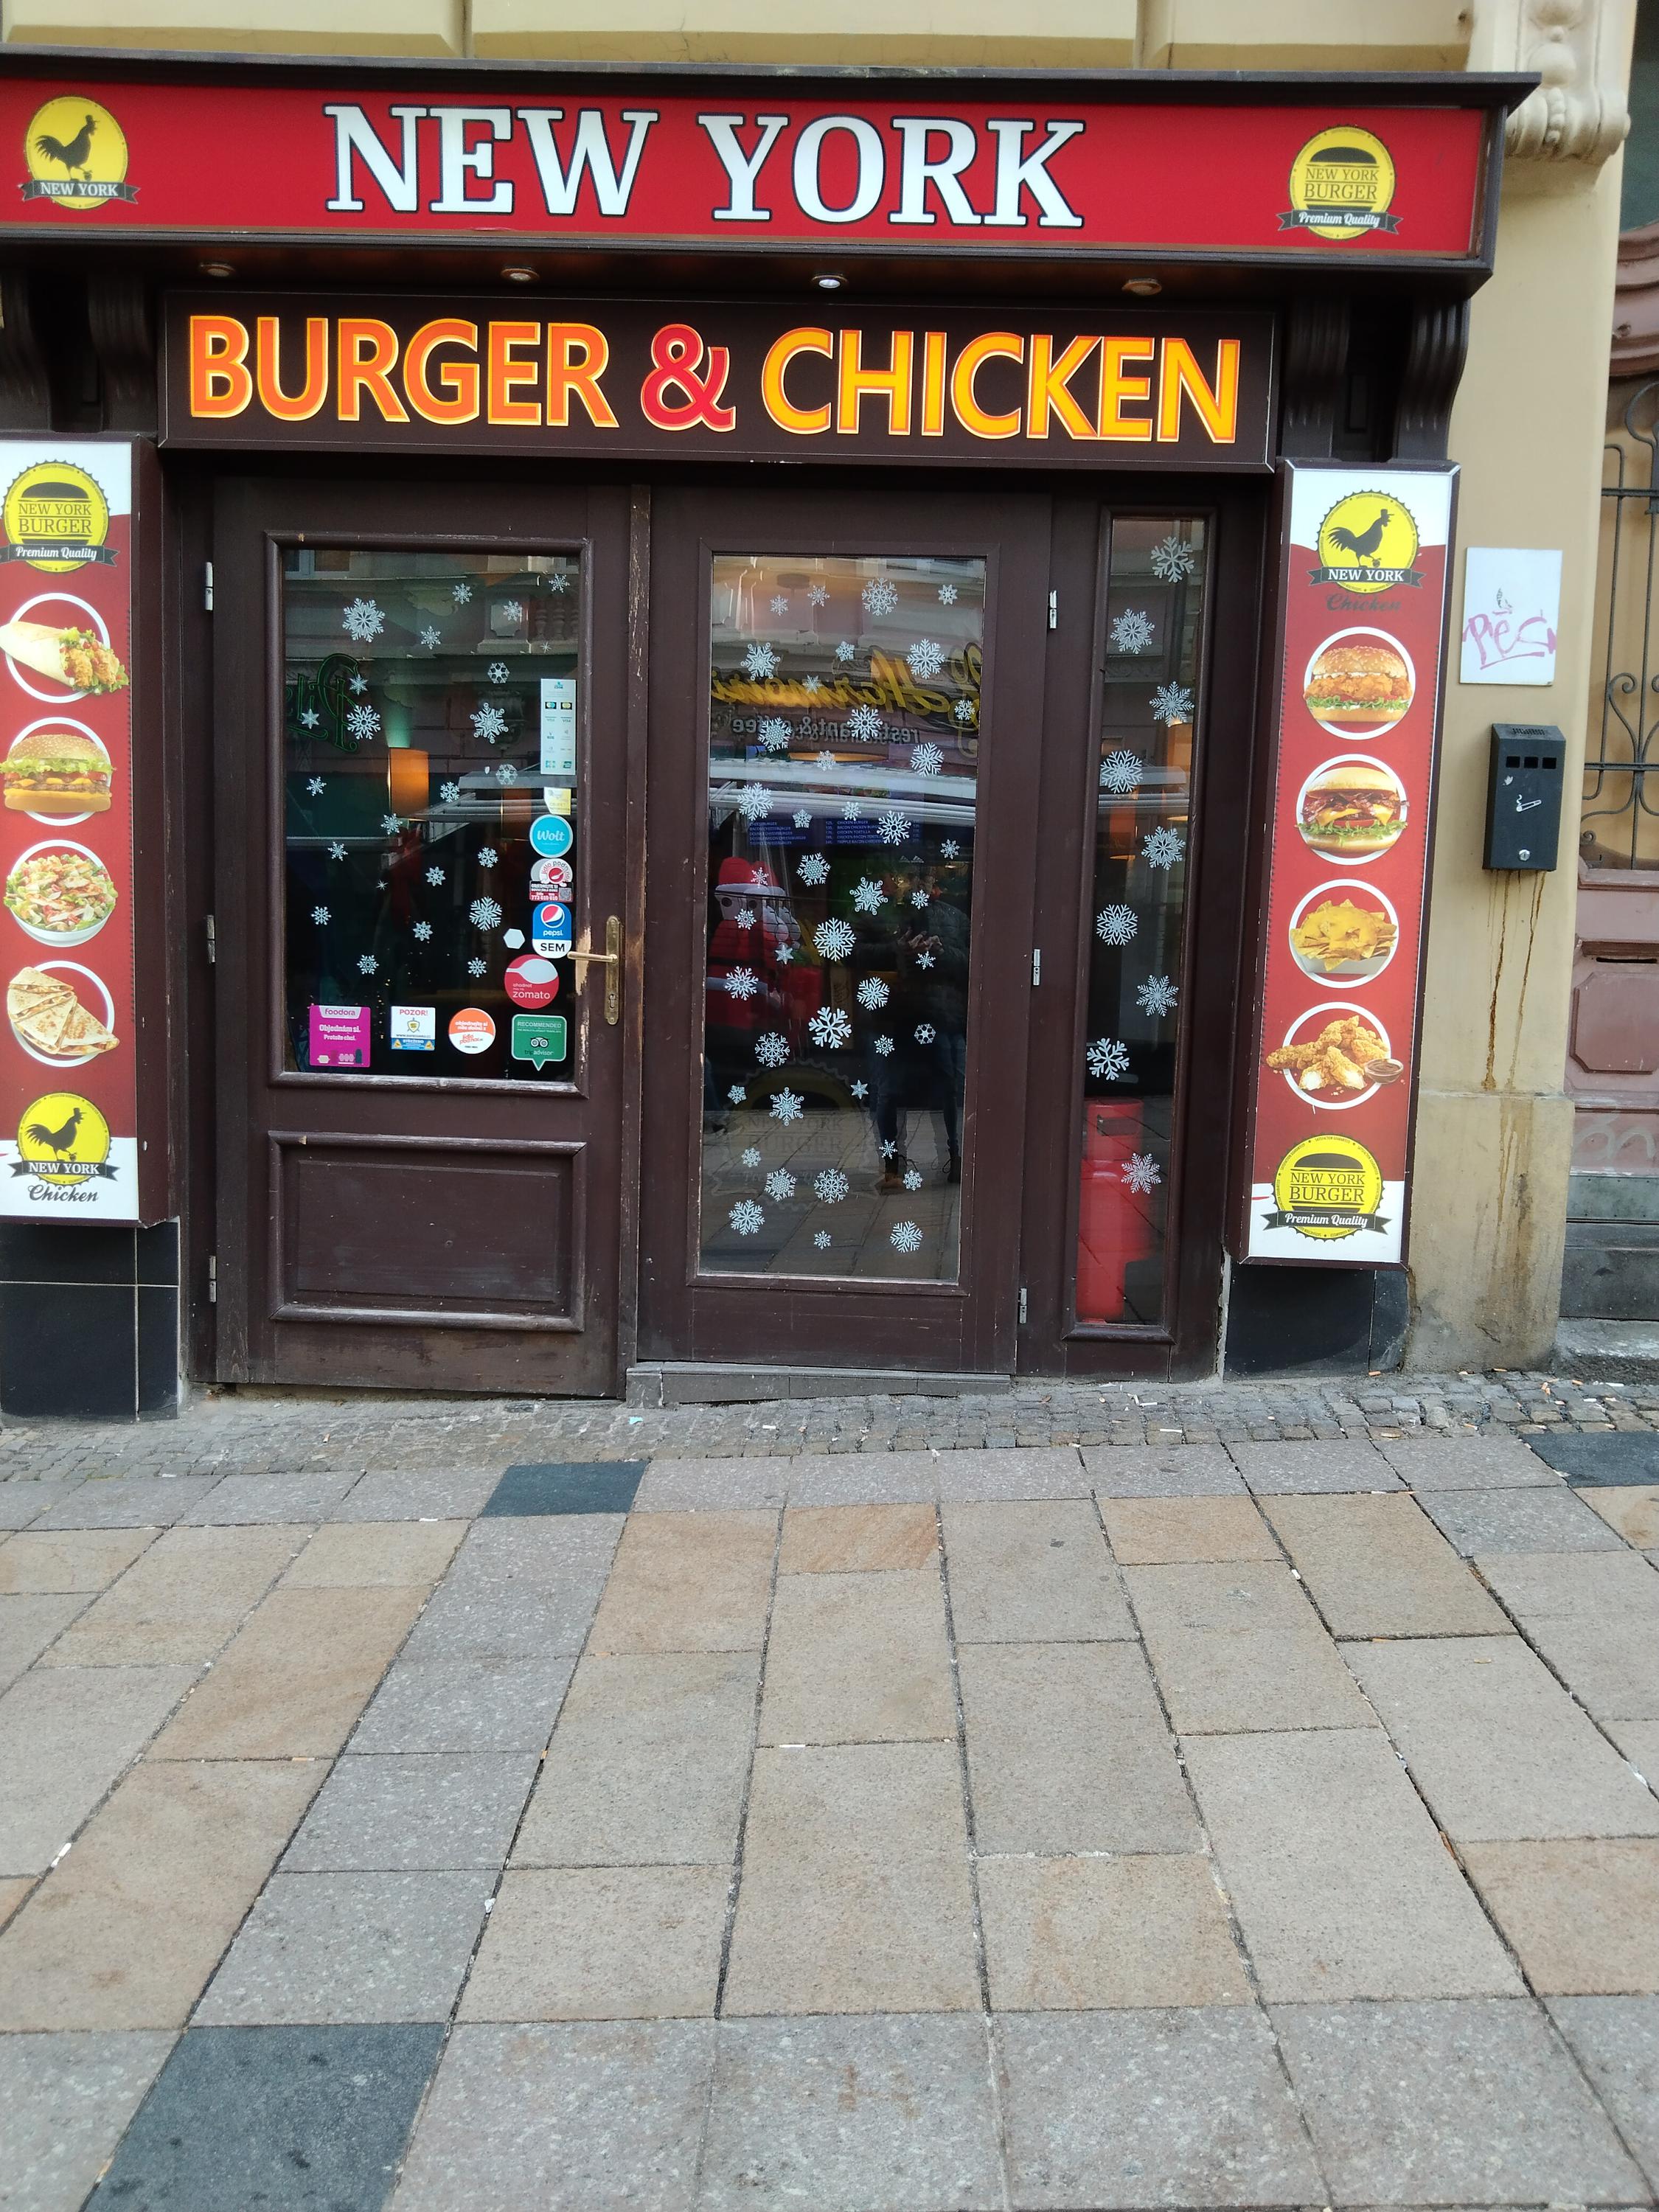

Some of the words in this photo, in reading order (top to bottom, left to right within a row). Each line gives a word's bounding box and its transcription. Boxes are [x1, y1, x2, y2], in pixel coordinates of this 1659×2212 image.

[323, 102, 659, 217] NEW
[696, 112, 1086, 229] YORK
[1305, 168, 1338, 180] NEW
[1343, 169, 1380, 181] YORK
[40, 182, 74, 195] NEW
[77, 184, 119, 196] YORK
[1304, 183, 1378, 200] BURGER
[1298, 212, 1342, 224] Premium
[1344, 214, 1381, 229] Quality
[189, 314, 620, 430] BURGER
[640, 322, 737, 433] &
[761, 327, 1241, 444] CHICKEN
[18, 504, 51, 515] NEW
[56, 504, 92, 515] YORK
[18, 518, 93, 534] BURGER
[15, 546, 59, 558] Premium
[60, 547, 97, 561] Quality
[1327, 568, 1363, 581] NEW
[1366, 569, 1405, 582] YORK
[1325, 593, 1401, 612] Chicken
[537, 830, 565, 841] Wolt
[540, 943, 565, 952] SEM
[512, 991, 550, 999] zomato
[29, 1162, 60, 1173] NEW
[63, 1163, 100, 1175] YORK
[1290, 1172, 1324, 1183] NEW
[1329, 1173, 1366, 1185] YORK
[27, 1185, 99, 1202] Chicken
[1290, 1186, 1365, 1203] BURGER
[1284, 1213, 1329, 1225] Premium
[1331, 1214, 1368, 1228] Quality
